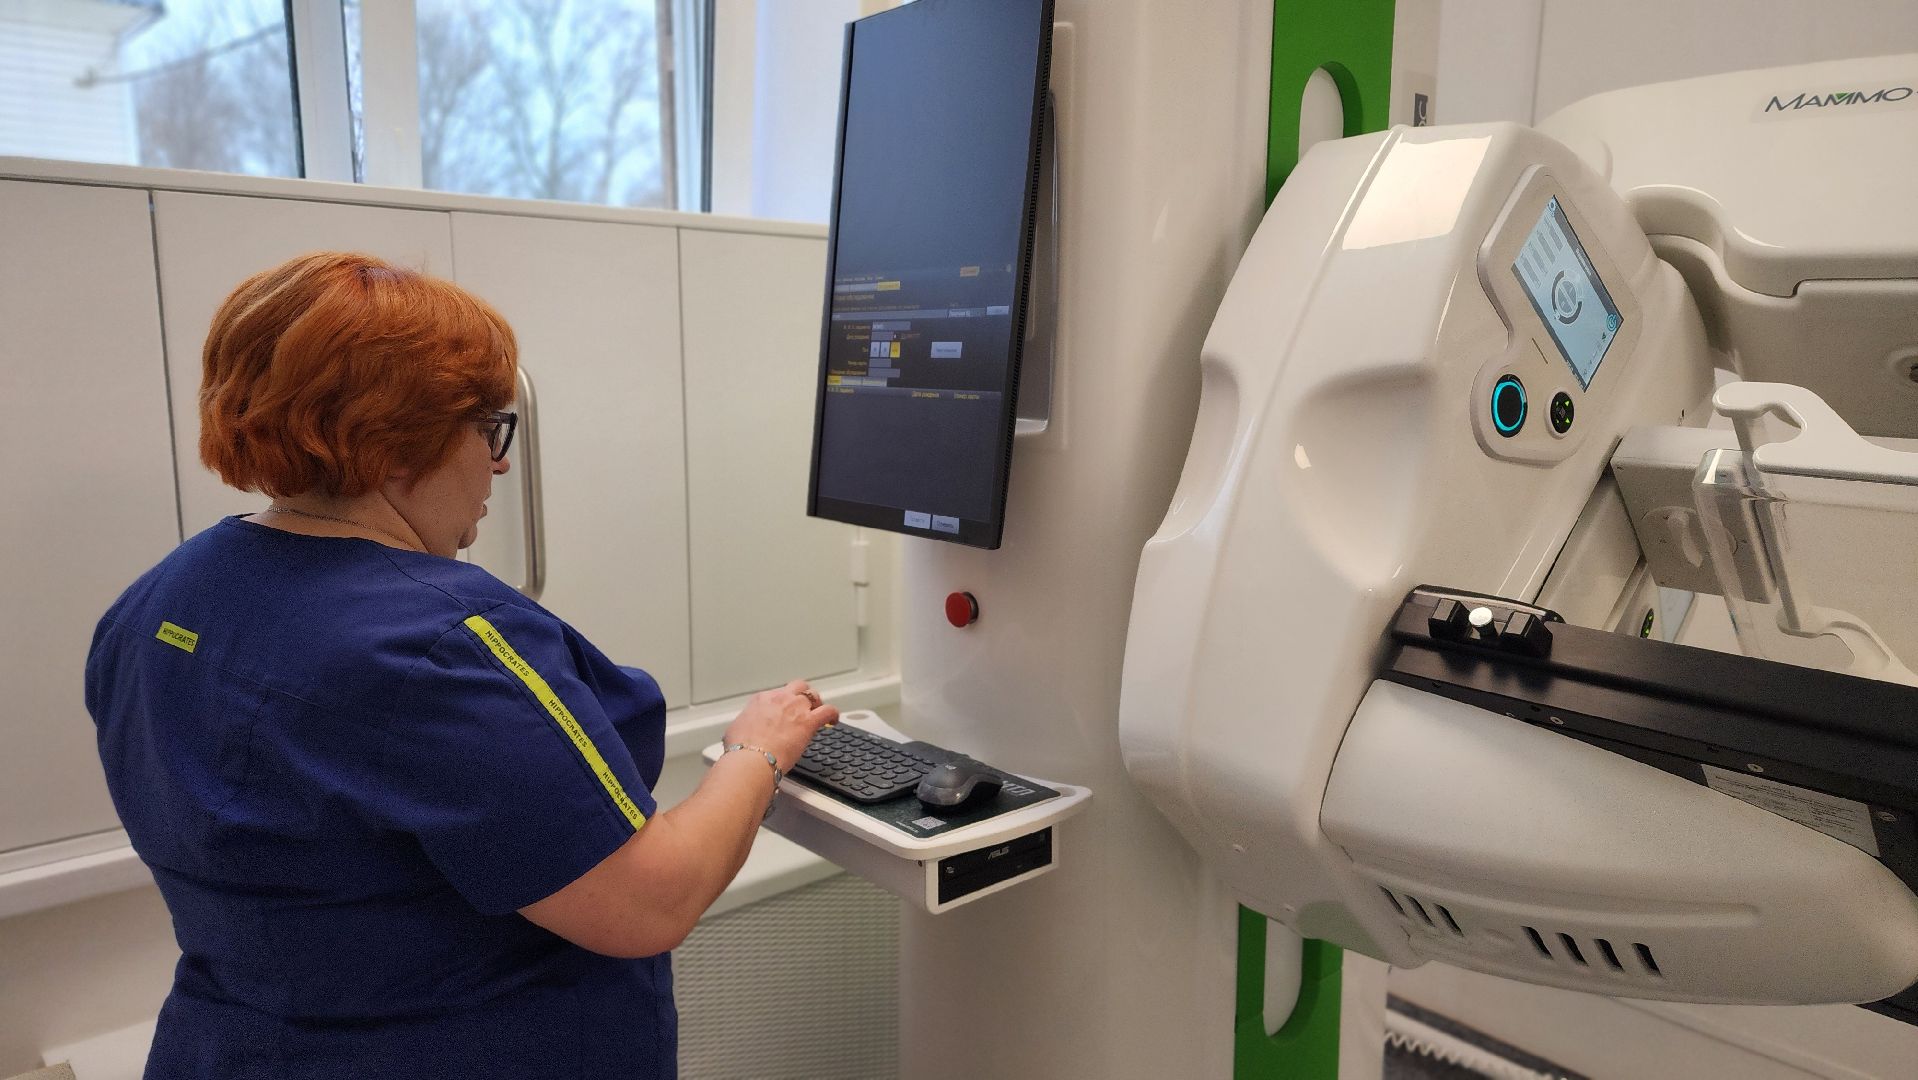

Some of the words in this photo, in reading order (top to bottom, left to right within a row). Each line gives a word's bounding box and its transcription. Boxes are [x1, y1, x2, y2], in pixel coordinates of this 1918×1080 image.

[1764, 87, 1914, 113] MAMMO
[162, 628, 196, 647] HIPPOCRATES
[484, 630, 530, 677] HIPPOCRATES
[548, 699, 588, 748] HIPPOCRATES
[602, 771, 638, 820] HIPPOCRATES
[987, 846, 1010, 860] ASUS
